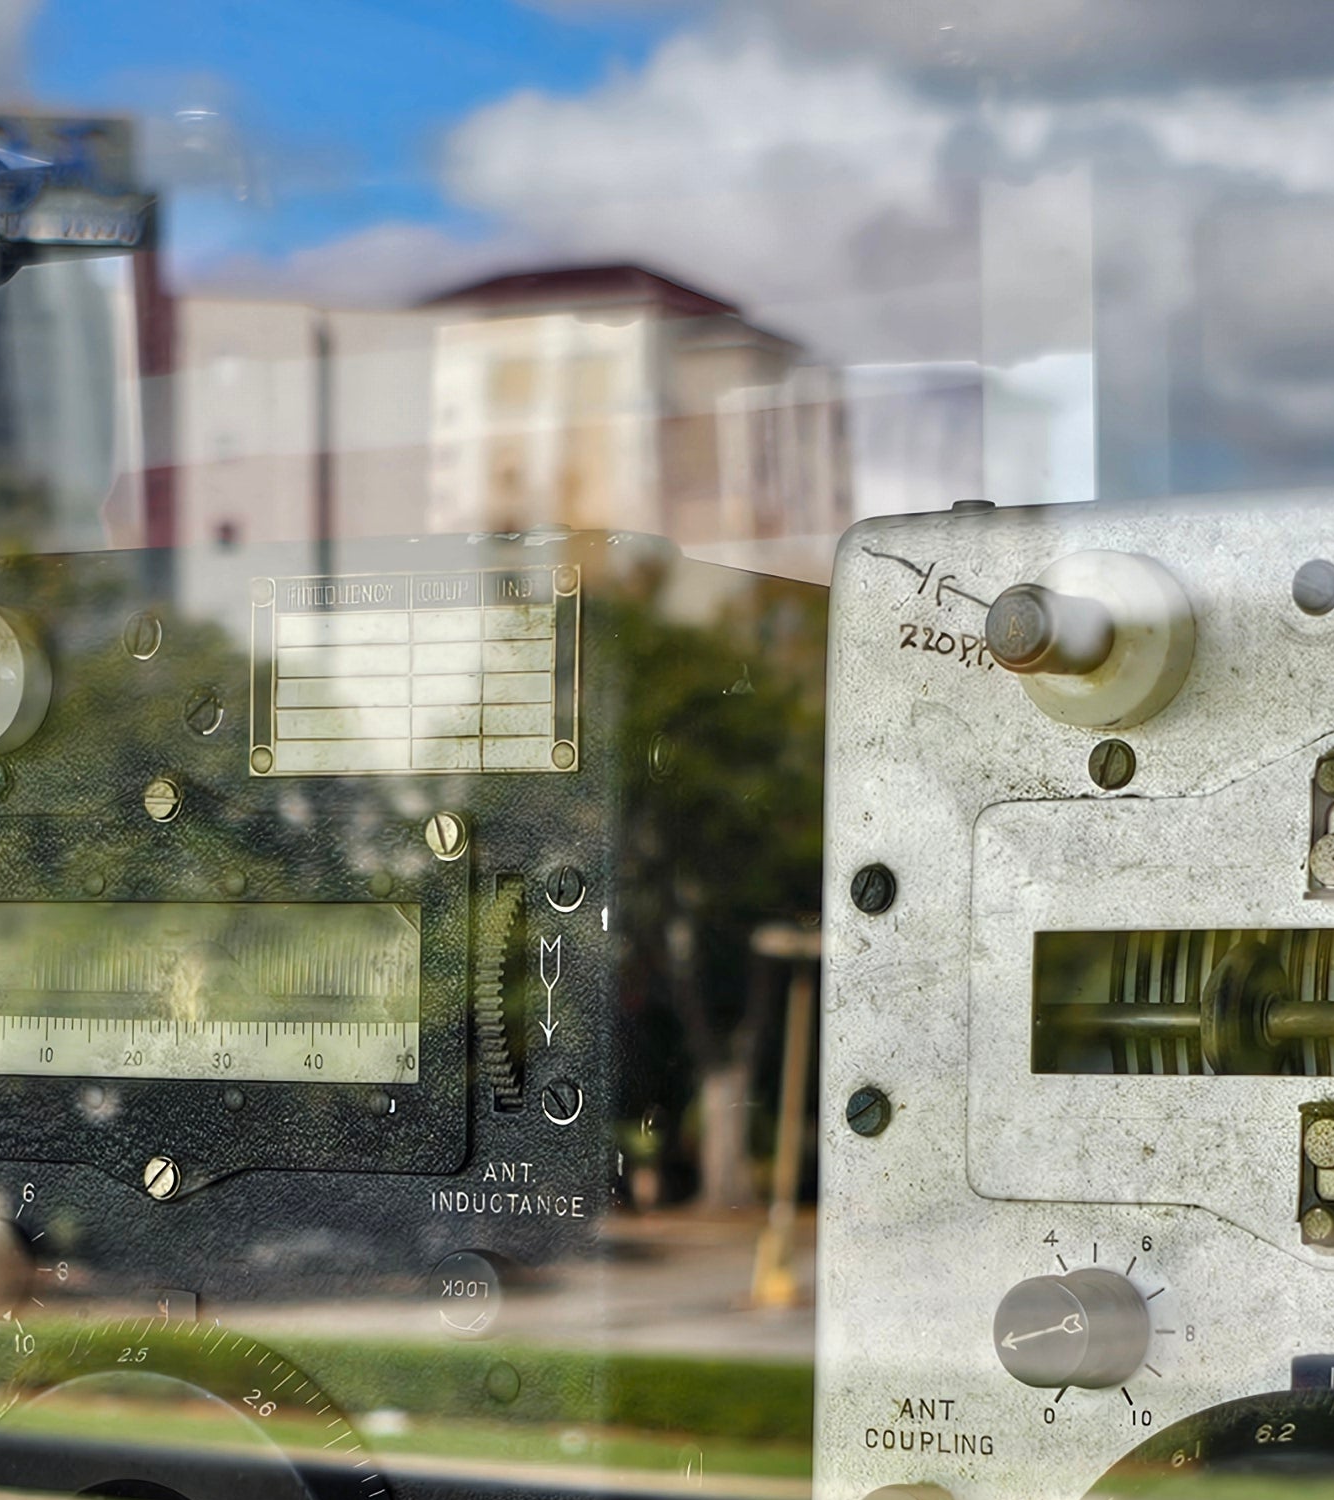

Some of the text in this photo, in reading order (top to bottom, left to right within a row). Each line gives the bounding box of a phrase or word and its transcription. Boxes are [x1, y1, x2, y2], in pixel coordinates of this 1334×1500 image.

[38, 1047, 54, 1063] 10
[123, 1051, 143, 1067] 20
[211, 1053, 232, 1070] 30
[303, 1054, 324, 1070] 40
[482, 1162, 536, 1184] ANT.
[23, 1184, 35, 1202] 6
[431, 1192, 585, 1218] INDUCTANCE
[1044, 1231, 1152, 1252] 4 6
[57, 1261, 68, 1281] 8
[441, 1279, 489, 1299] LOCK
[1185, 1325, 1195, 1342] 8
[15, 1334, 35, 1354] 10
[117, 1347, 149, 1363] 2.5
[243, 1389, 277, 1417] 2.6
[899, 1399, 958, 1421] ANT.
[1044, 1408, 1152, 1427] 0 10
[865, 1428, 994, 1456] COUPLING
[1255, 1424, 1296, 1442] 6.2
[1172, 1441, 1201, 1467] 6.1
